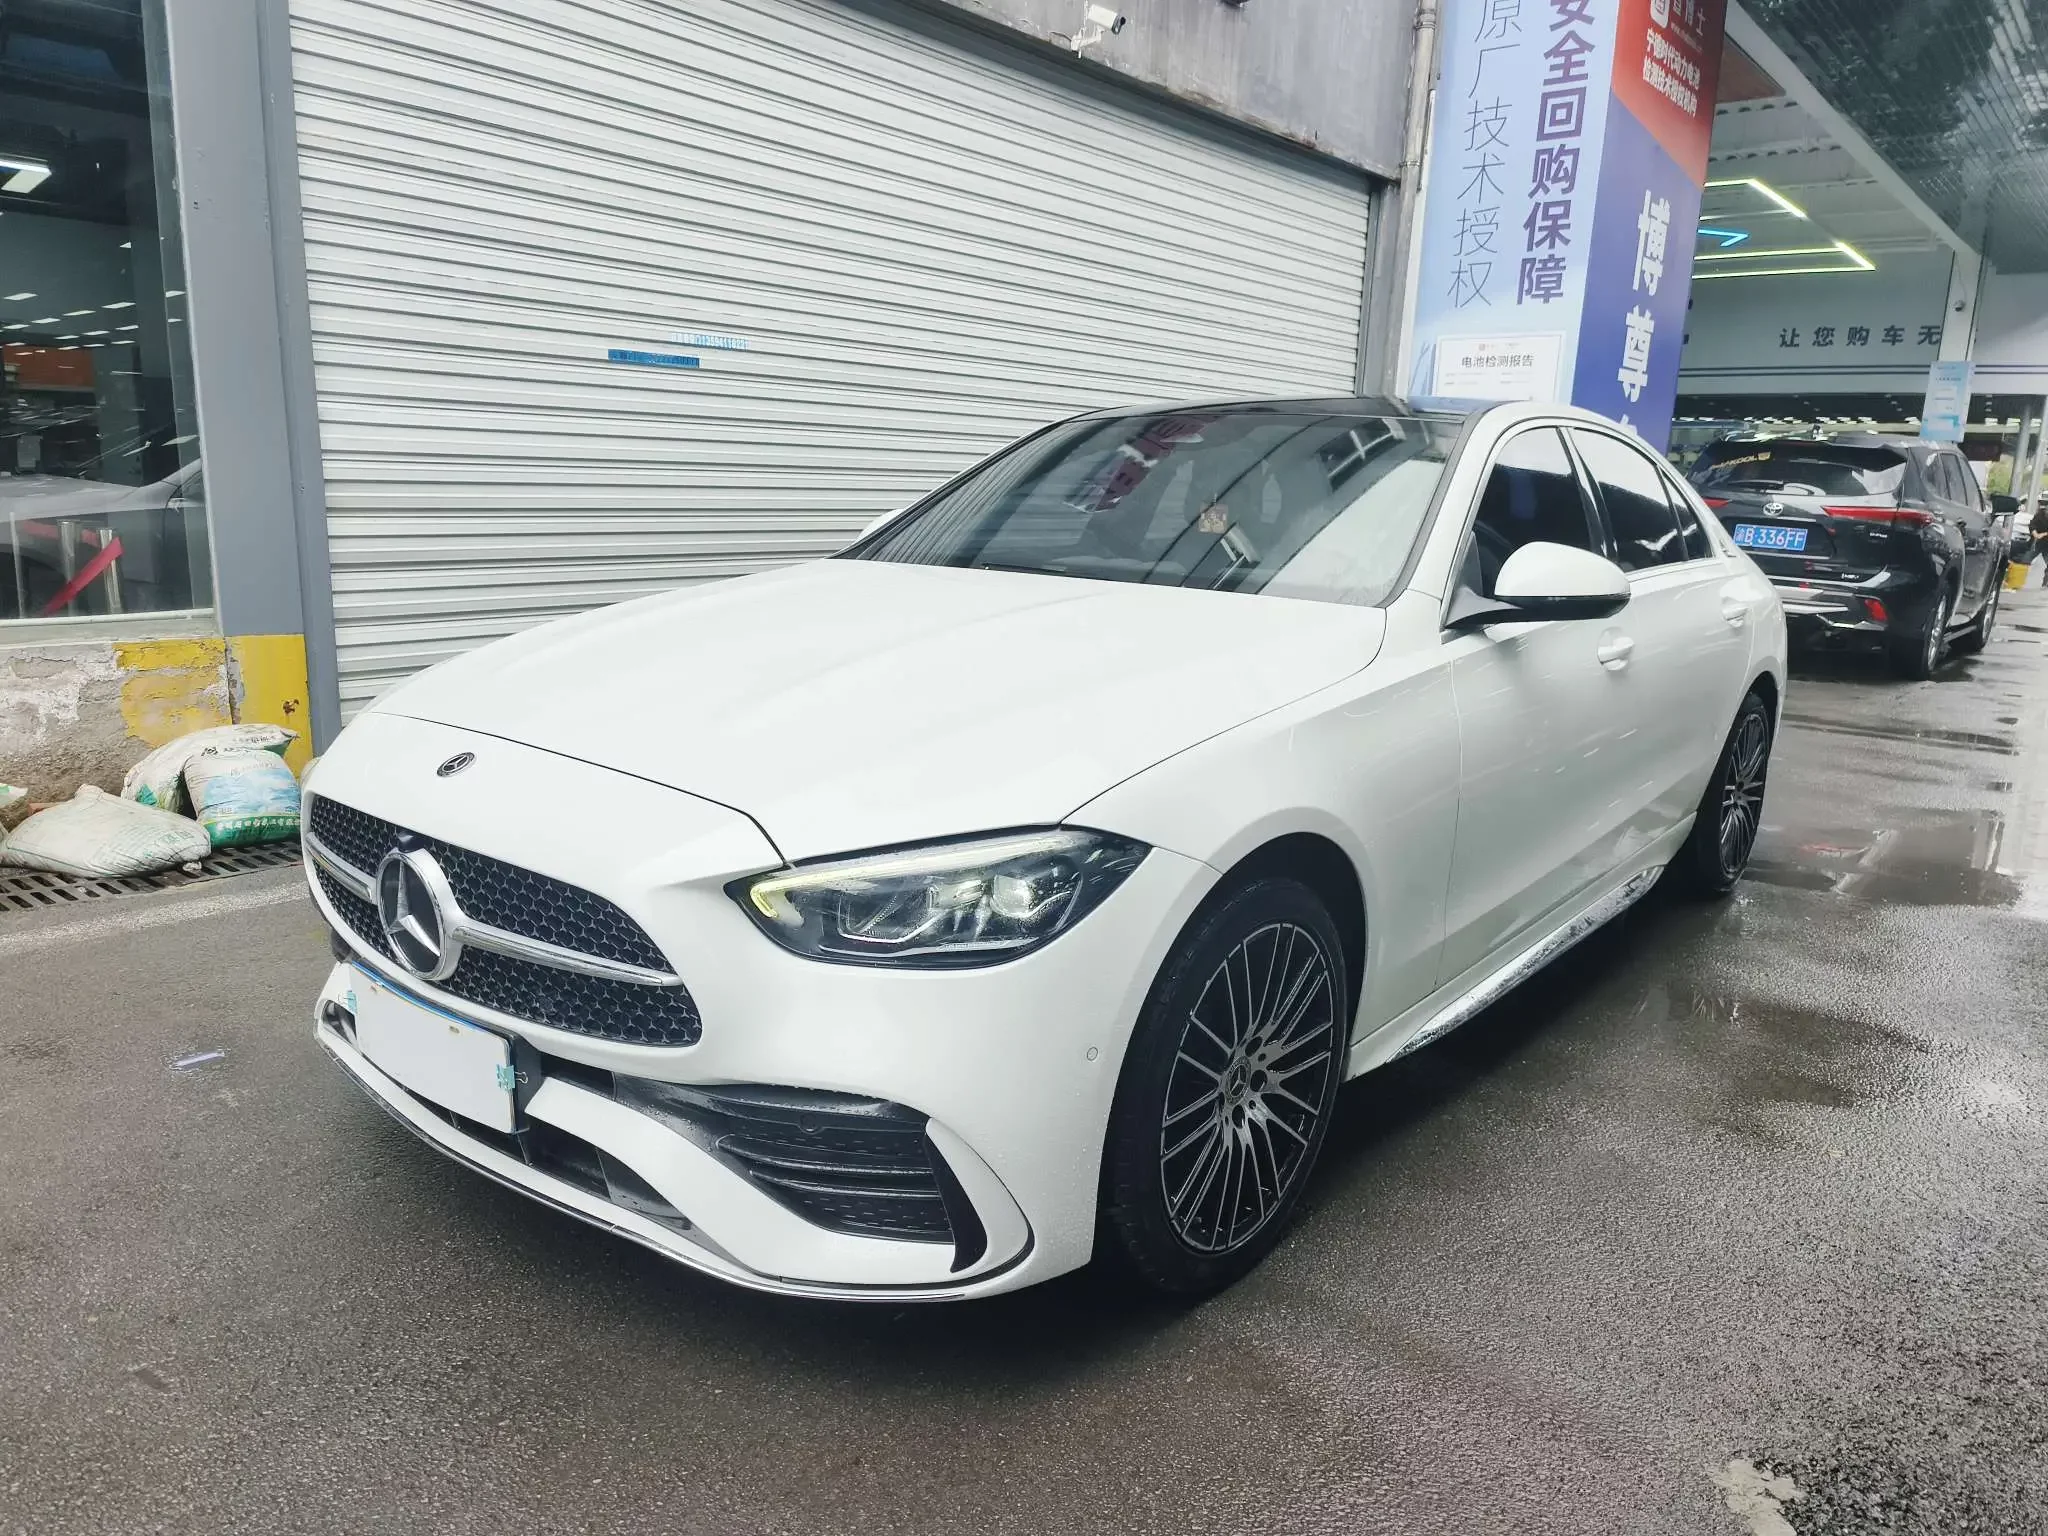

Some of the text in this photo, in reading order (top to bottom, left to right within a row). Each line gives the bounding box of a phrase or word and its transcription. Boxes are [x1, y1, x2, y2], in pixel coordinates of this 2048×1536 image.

[1447, 0, 1521, 308] 原厂技术授权
[1461, 353, 1535, 369] 电池检测报告
[1618, 190, 1671, 436] 博尊
